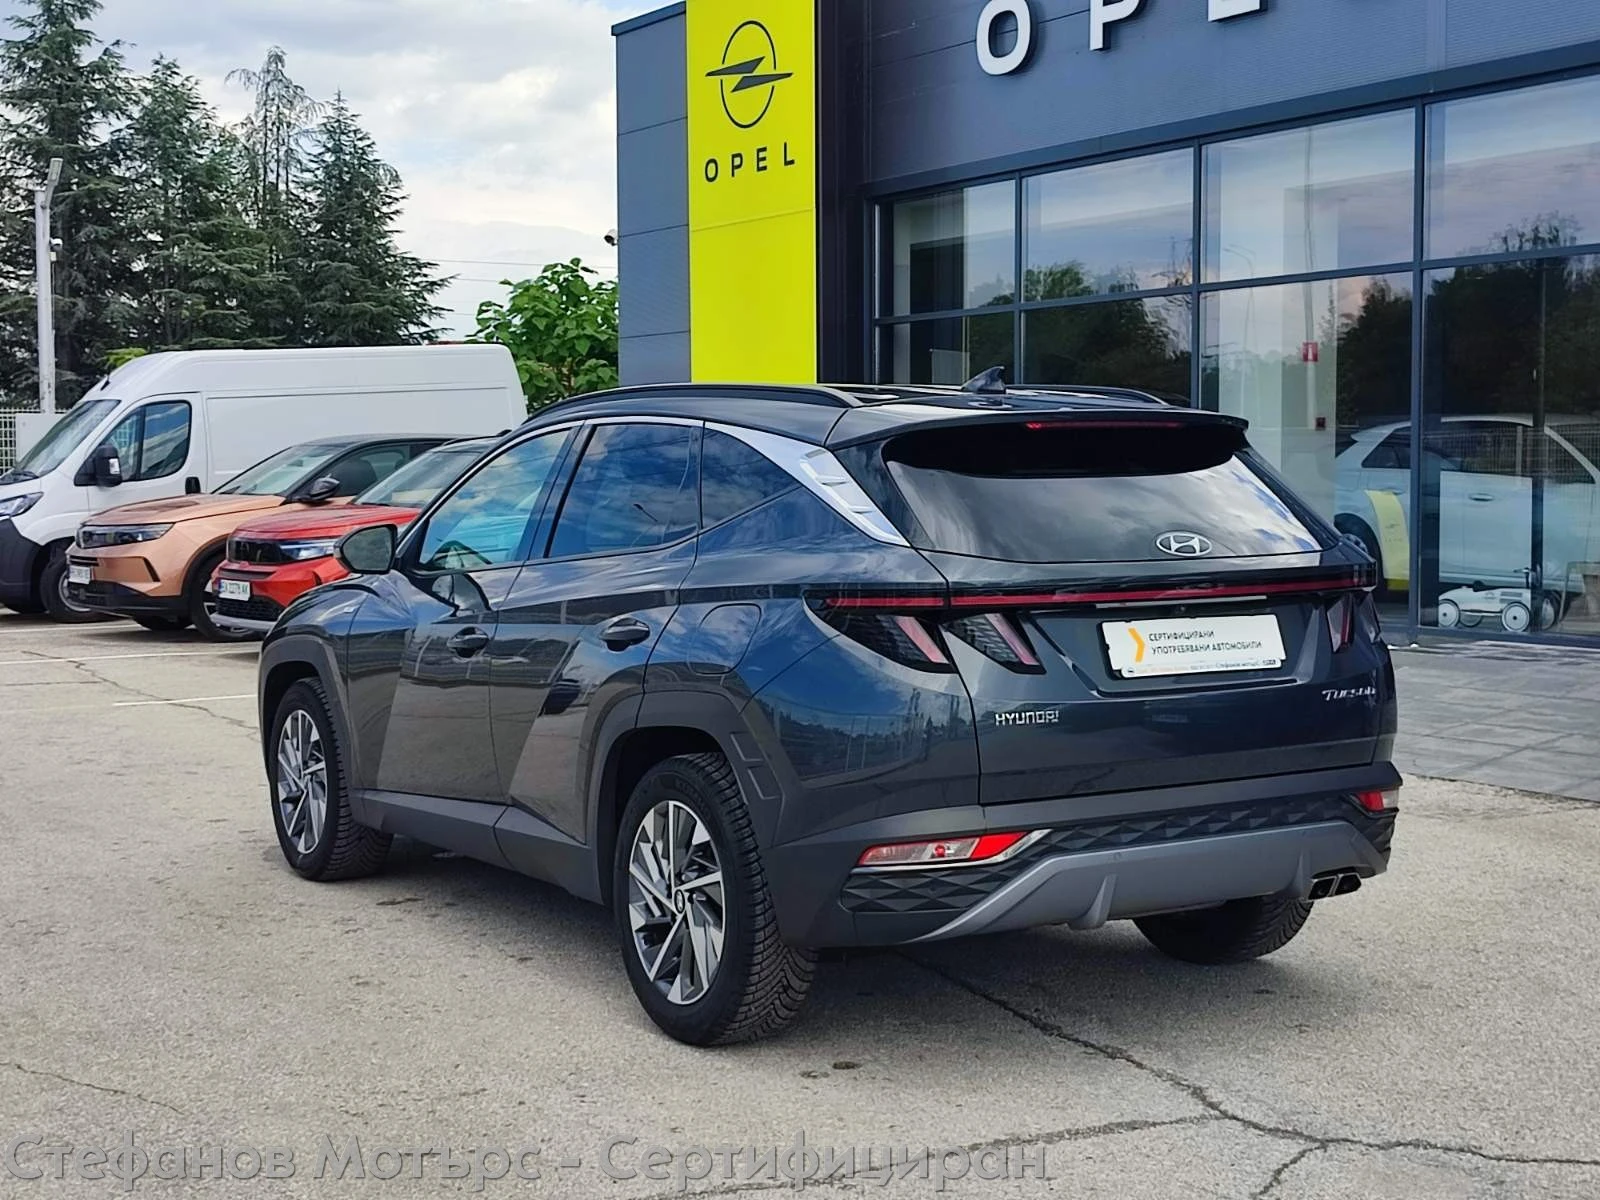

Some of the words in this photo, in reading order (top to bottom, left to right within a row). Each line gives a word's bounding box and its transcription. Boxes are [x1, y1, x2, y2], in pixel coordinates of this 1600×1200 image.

[976, 0, 1261, 75] OP
[704, 141, 796, 183] OPEL
[1148, 630, 1214, 642] СЕРТИФИЦИРАНИ
[1151, 642, 1210, 655] УПОТРЕБЯВАНИ
[1211, 640, 1262, 652] АВТОМОБИЛИ
[995, 710, 1059, 726] HYUNDAI
